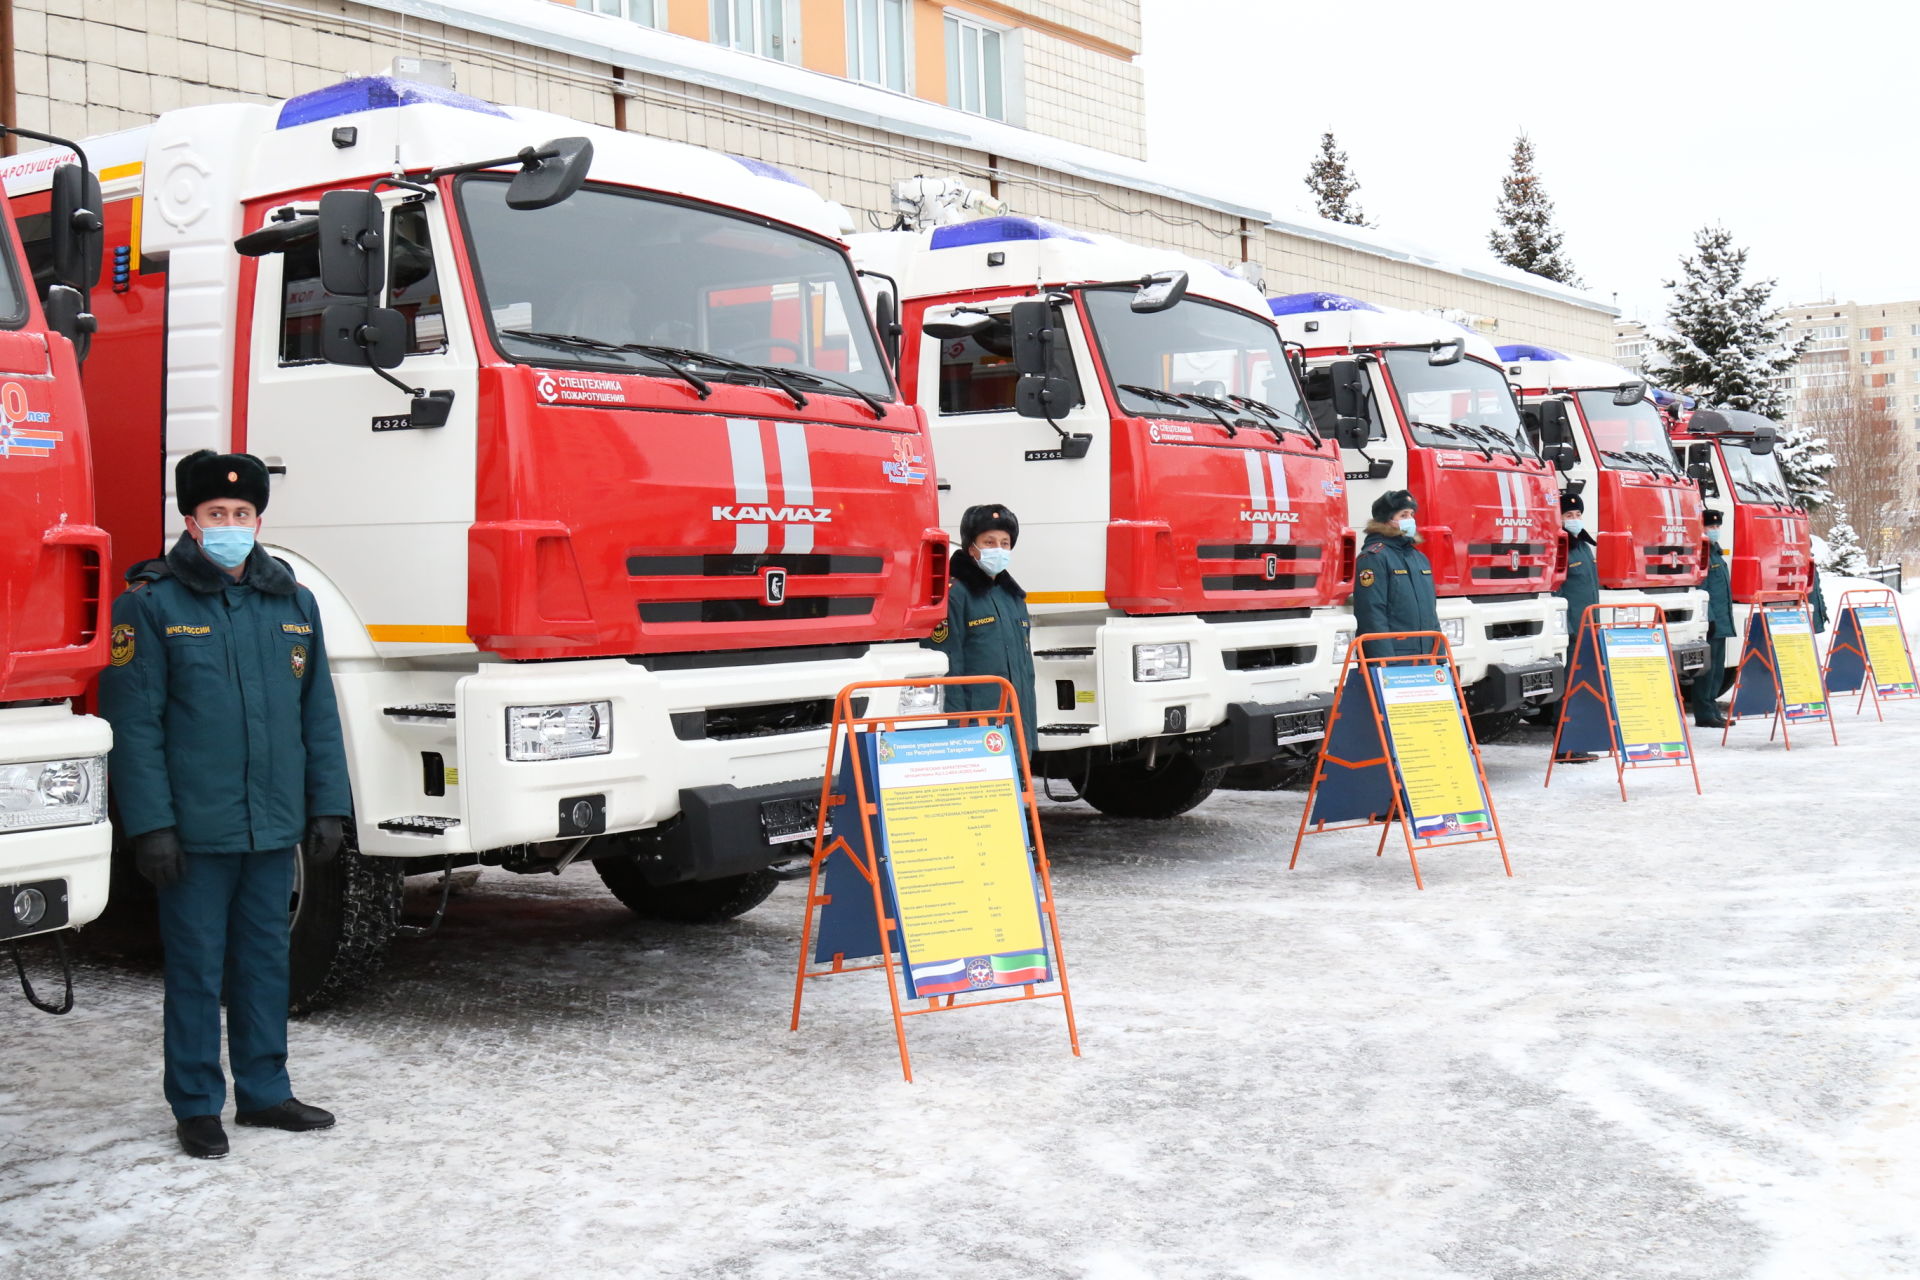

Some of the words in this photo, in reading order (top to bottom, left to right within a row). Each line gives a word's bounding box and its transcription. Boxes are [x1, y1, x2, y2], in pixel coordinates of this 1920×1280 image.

[558, 376, 622, 391] СПЕЦТЕХНИКА
[561, 390, 626, 403] ПОЖАРОТУШЕНИЯ
[27, 411, 50, 423] лет
[374, 418, 413, 429] 4326
[891, 435, 914, 463] 30
[1027, 452, 1062, 460] 43265
[712, 506, 832, 522] KAMAZ
[1240, 511, 1300, 522] KAMAZ
[1495, 518, 1533, 527] KAMAZ
[1661, 525, 1687, 533] KAMAZ
[166, 625, 182, 635] МЧС
[183, 625, 210, 635] РОССИИ
